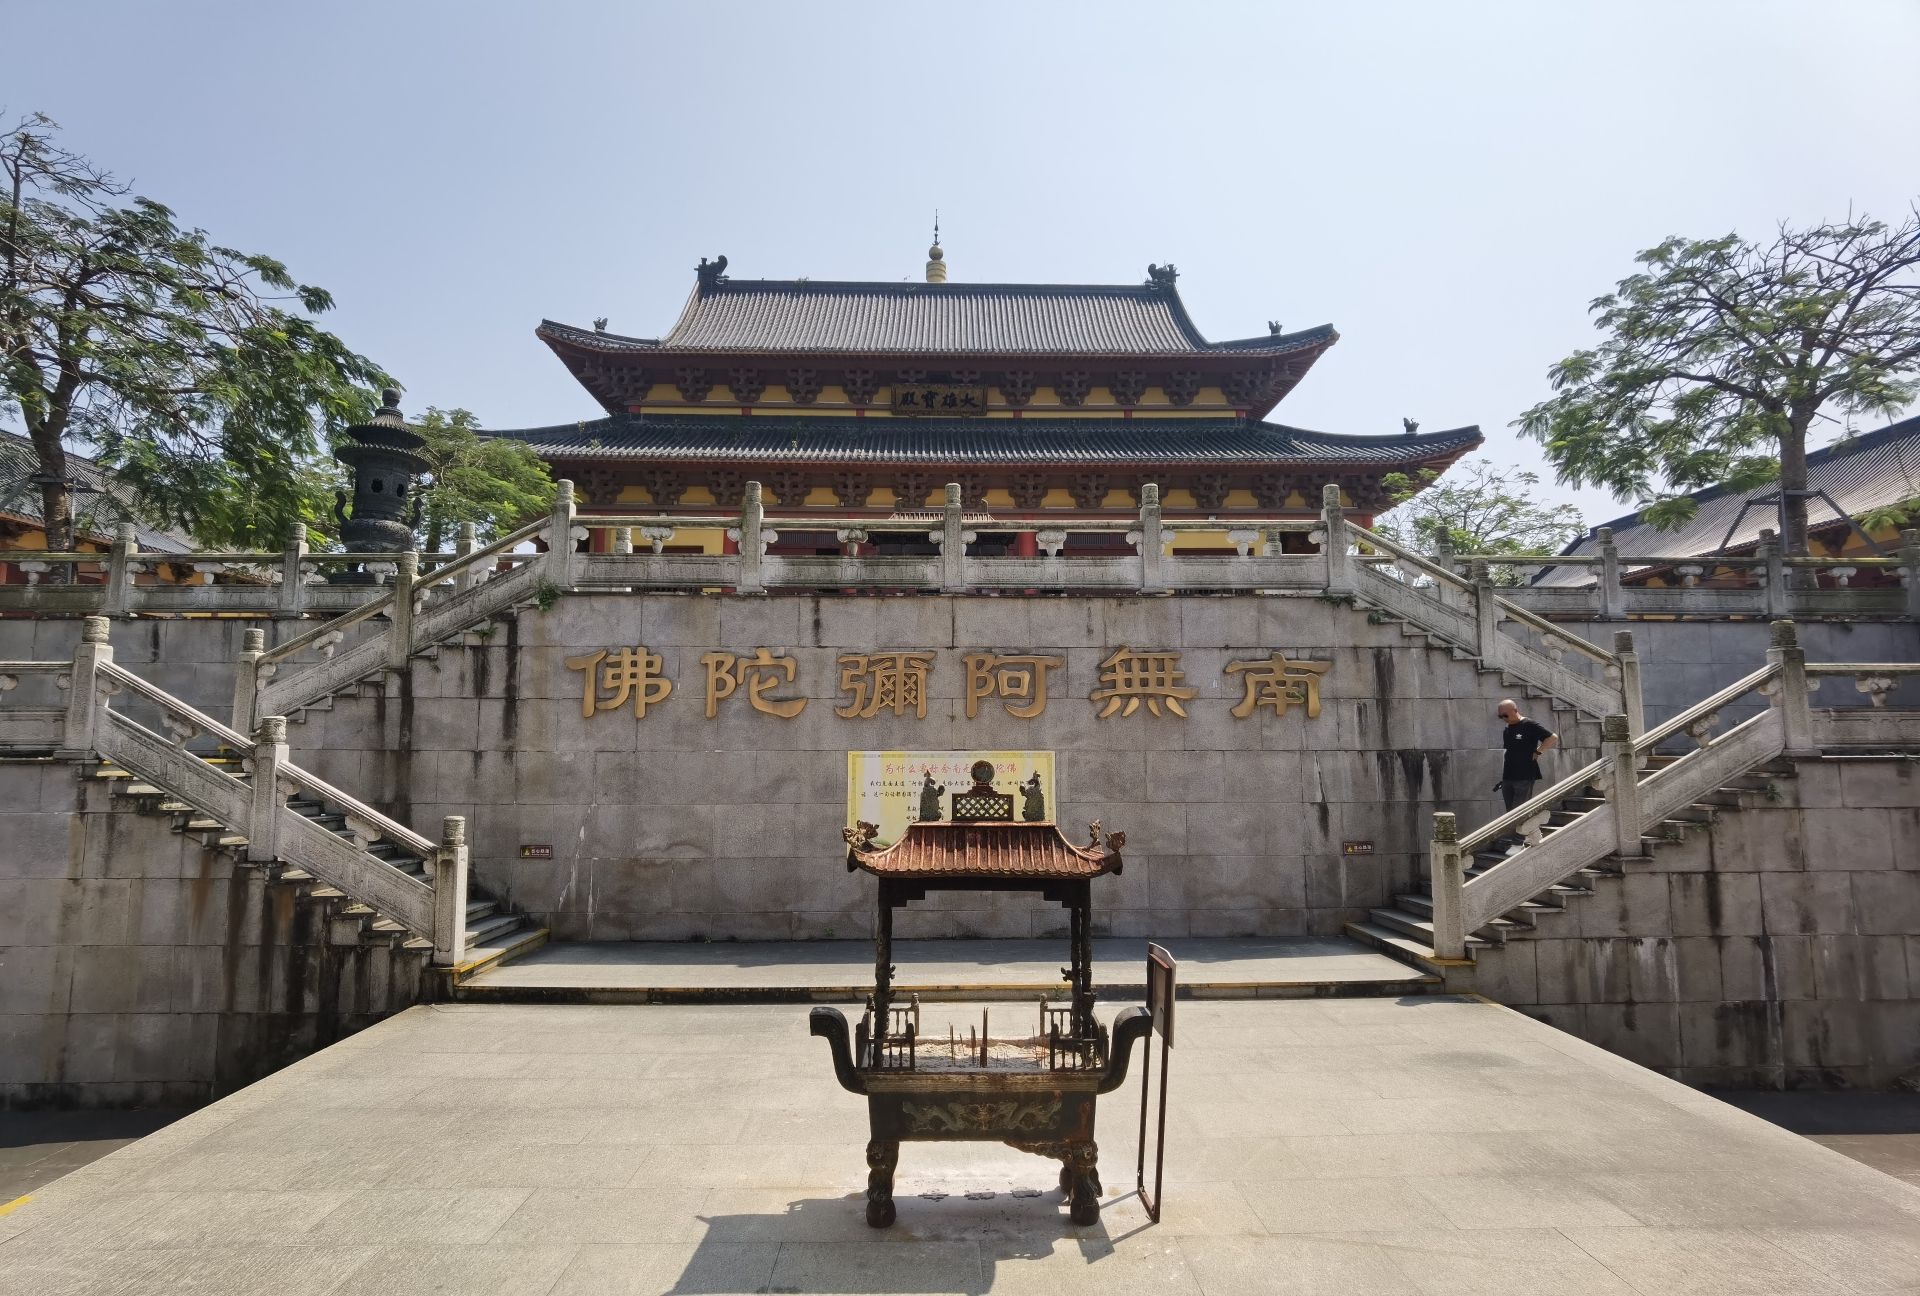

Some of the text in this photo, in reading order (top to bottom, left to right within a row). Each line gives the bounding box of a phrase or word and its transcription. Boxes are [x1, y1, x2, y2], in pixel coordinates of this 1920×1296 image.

[885, 762, 1017, 775] 为什么要称念南无陀佛
